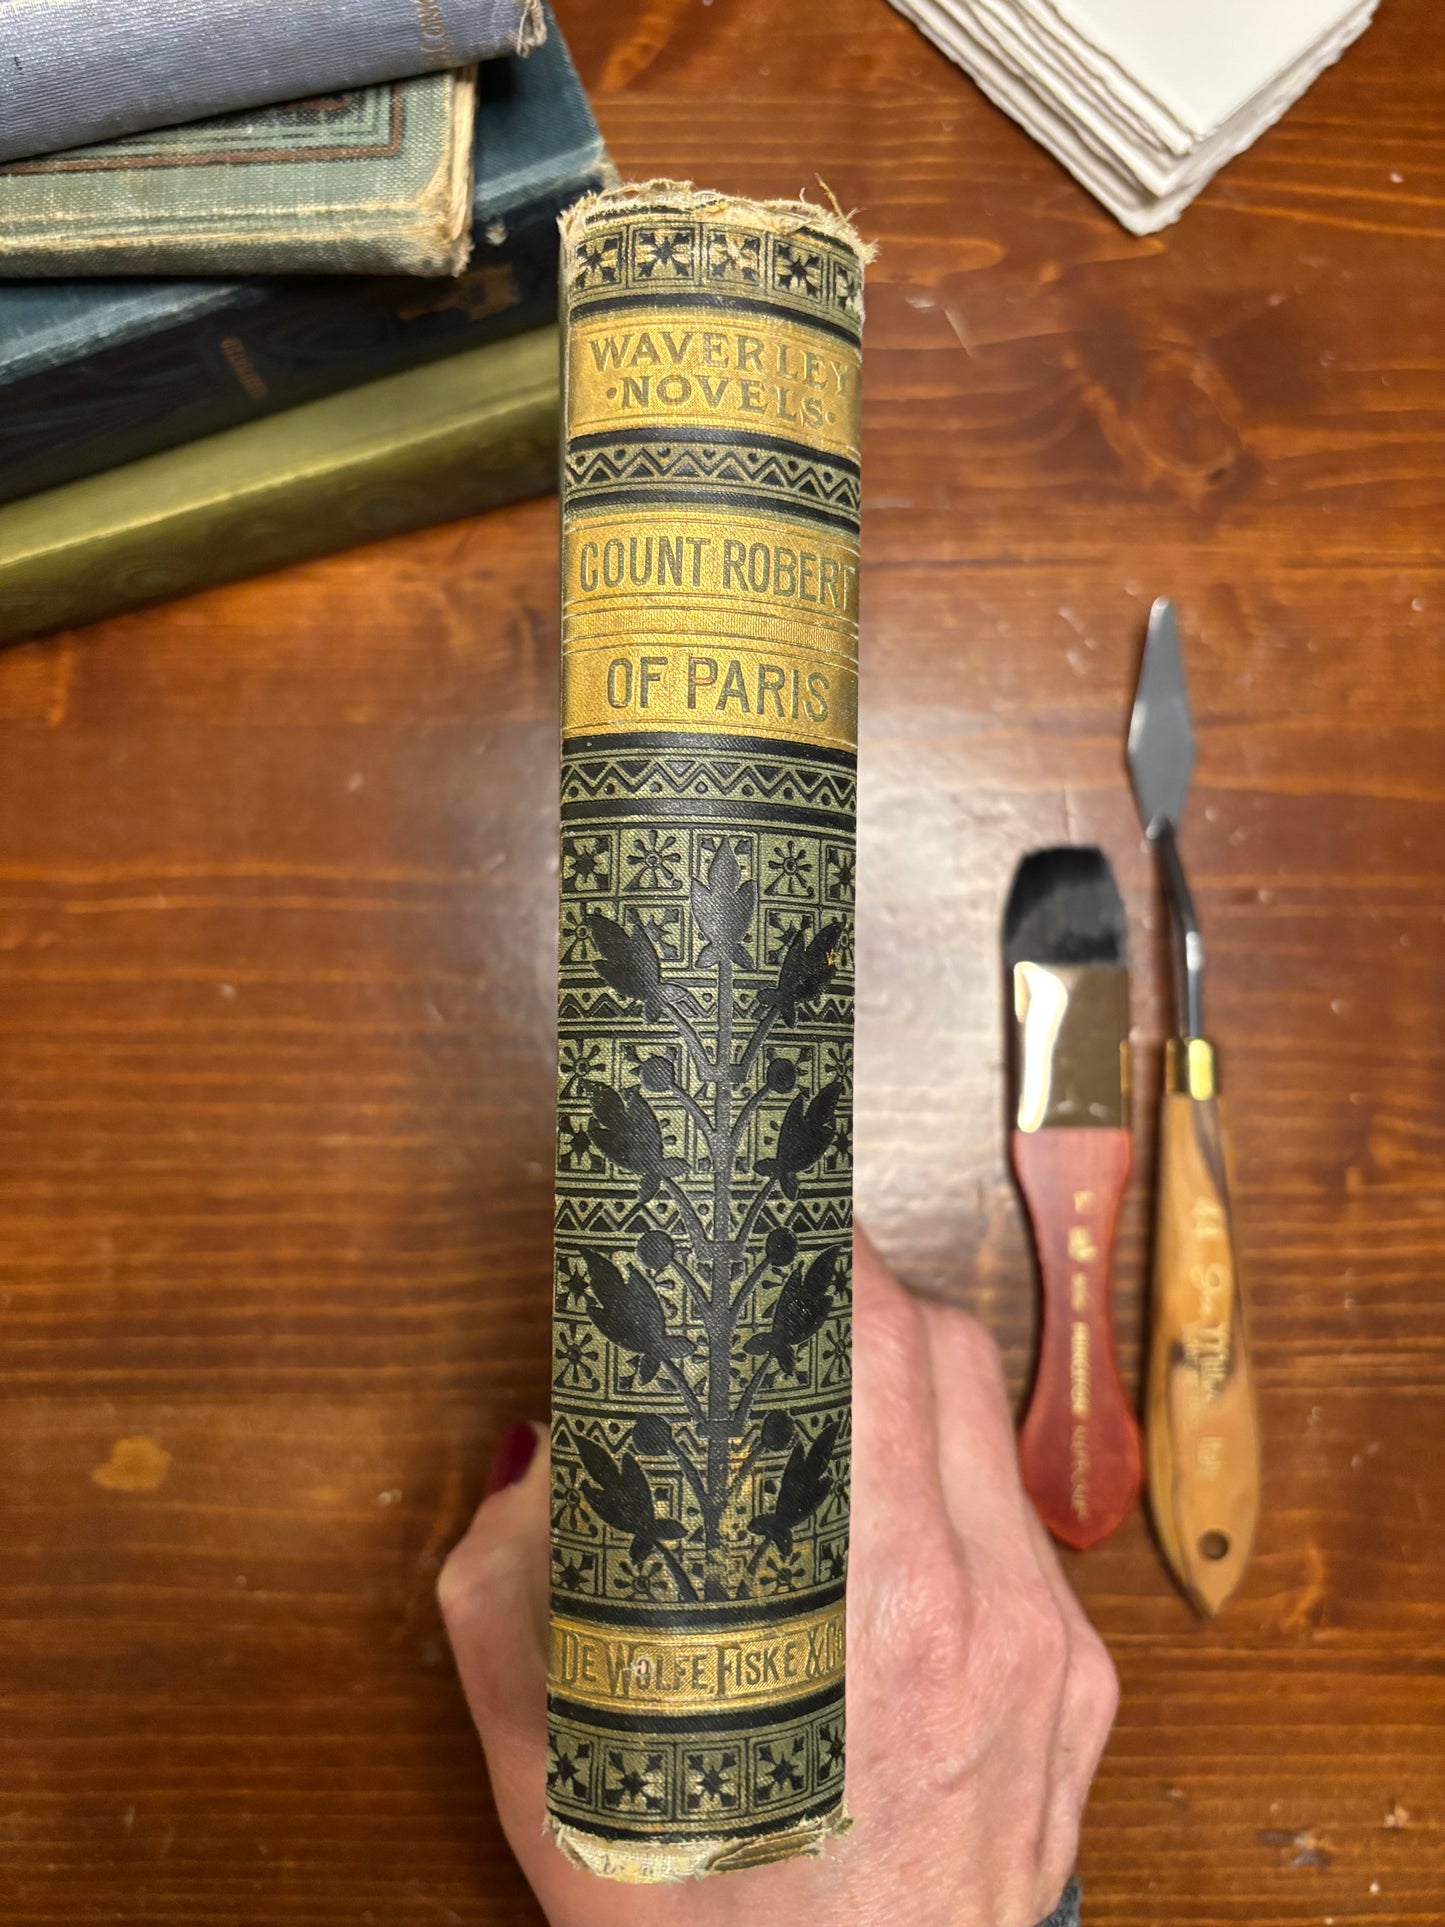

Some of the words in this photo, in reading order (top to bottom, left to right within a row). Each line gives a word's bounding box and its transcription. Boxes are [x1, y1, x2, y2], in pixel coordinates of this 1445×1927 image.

[590, 330, 851, 393] WAVERLEY
[580, 535, 711, 593] COUNT
[723, 539, 857, 612] ROBERT
[607, 656, 669, 709] OF
[688, 657, 830, 722] PARIS
[562, 1630, 597, 1686] DE
[717, 1639, 797, 1697] FISKE
